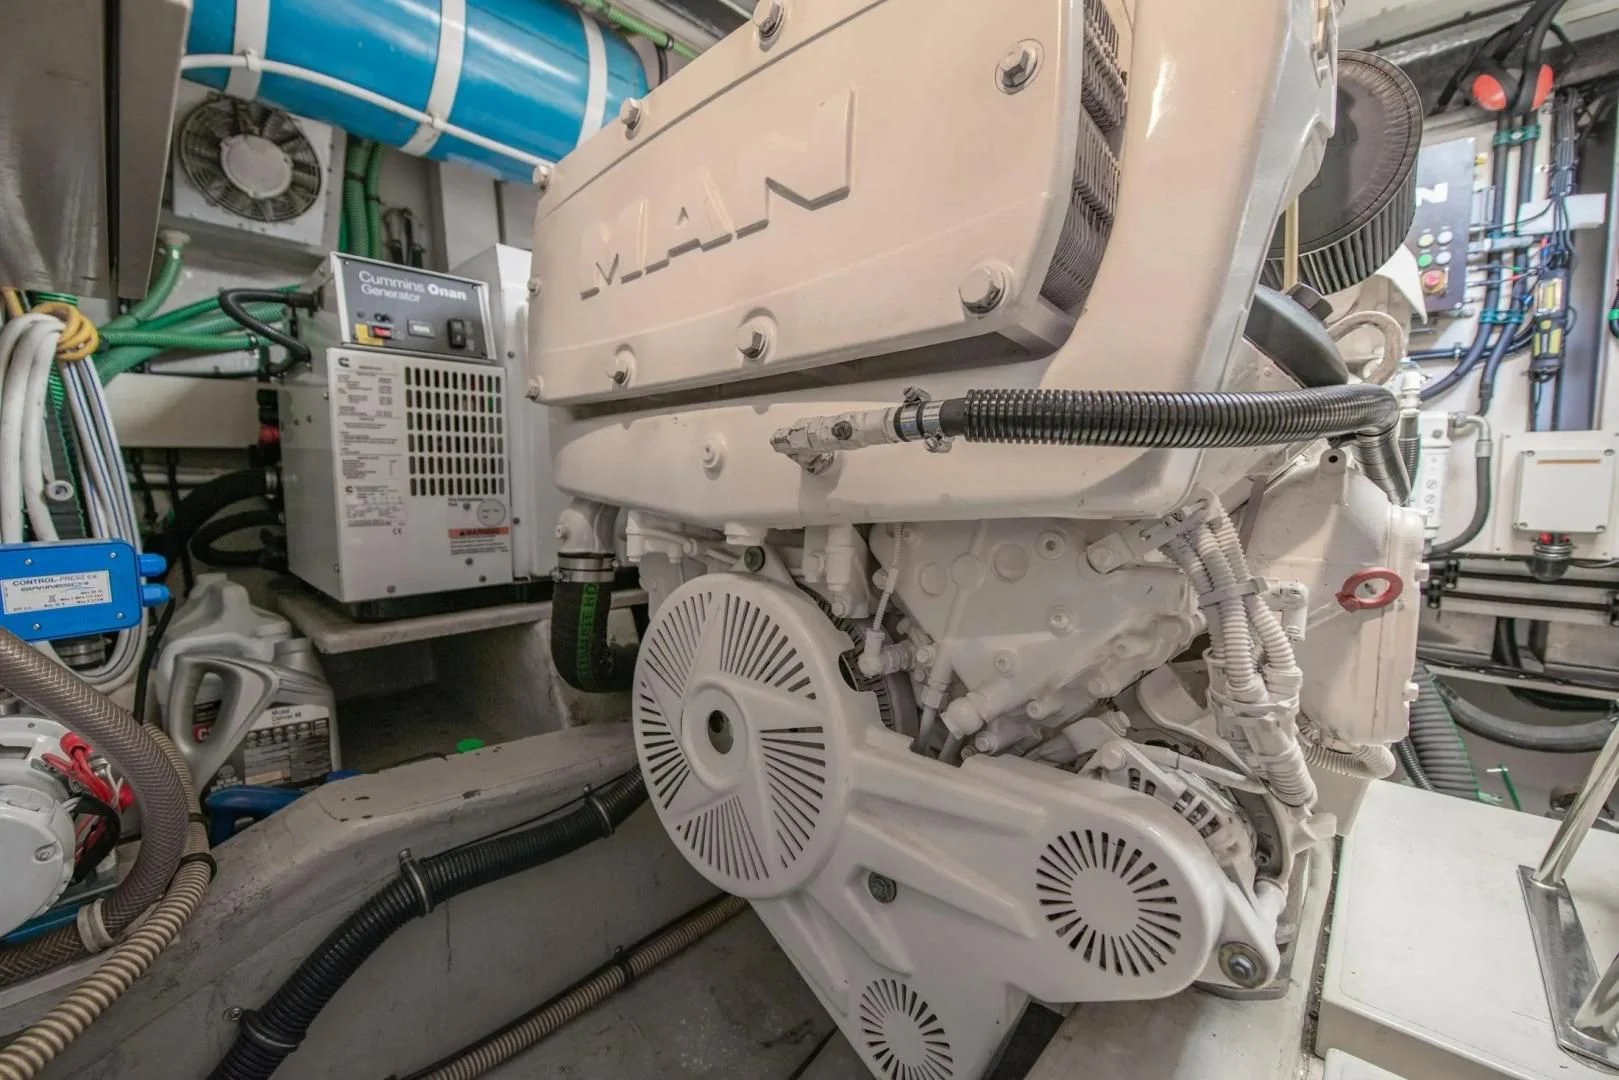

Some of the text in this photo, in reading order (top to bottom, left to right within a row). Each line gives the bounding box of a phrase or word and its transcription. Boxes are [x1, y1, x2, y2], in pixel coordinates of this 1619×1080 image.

[581, 86, 857, 301] MAN
[358, 270, 468, 301] Cummins Onan
[360, 283, 421, 303] Generator
